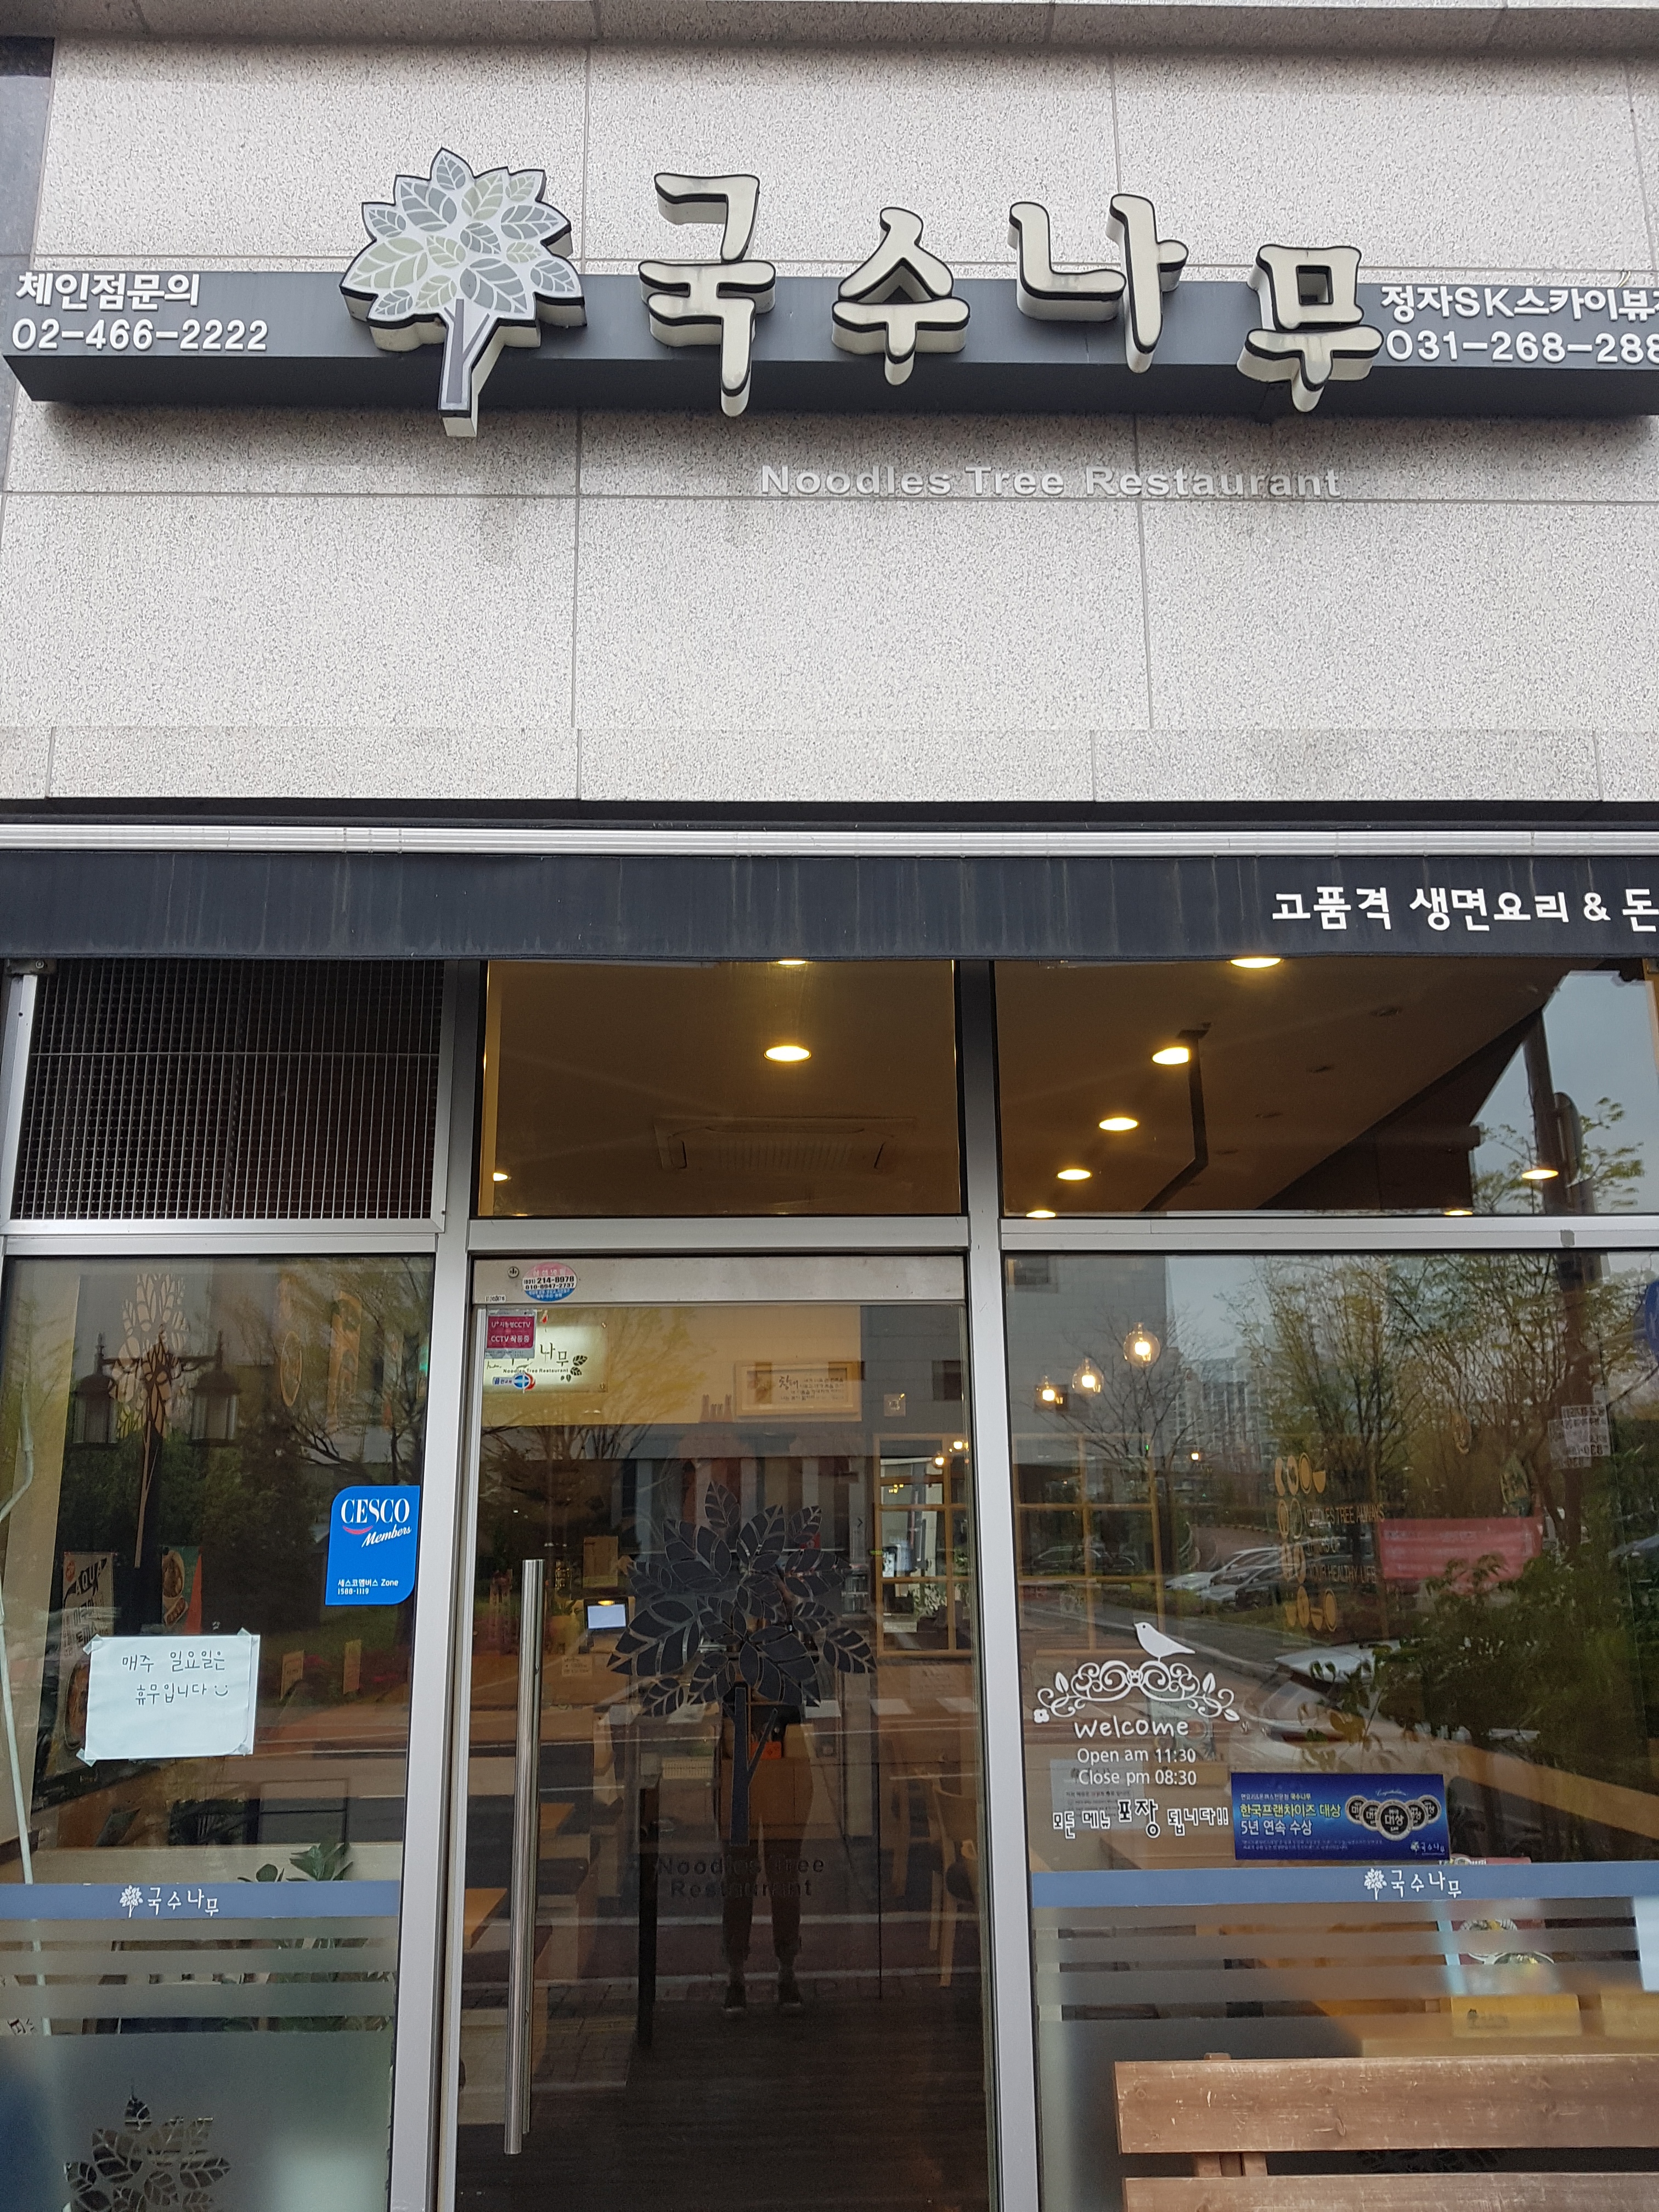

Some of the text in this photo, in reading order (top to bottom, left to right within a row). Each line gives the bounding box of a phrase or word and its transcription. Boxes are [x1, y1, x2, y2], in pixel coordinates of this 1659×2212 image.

[16, 272, 200, 311] 체인점문의
[637, 171, 1385, 413] 국수나무
[1381, 285, 1659, 323] 정자SK스카이뷰
[12, 318, 268, 351] 02-466-2222
[760, 465, 1341, 498] Noodles Tree Restaurant
[1272, 887, 1659, 932] 고품격 생면요리 & 돈
[341, 1498, 410, 1523] CESCO
[361, 1523, 412, 1548] Members
[76, 1559, 103, 1596] AQUA
[381, 1578, 399, 1587] Zone
[122, 1650, 225, 1673] 매주 일요일은
[136, 1682, 207, 1706] 휴무입니다
[1077, 1748, 1197, 1765] Open am 11:30
[1079, 1769, 1120, 1785] Close
[1126, 1771, 1150, 1786] pm
[1155, 1770, 1197, 1786] 08:30
[1053, 1811, 1075, 1839] 모든
[1082, 1810, 1111, 1829] 메뉴
[1118, 1799, 1161, 1838] 포장
[1240, 1803, 1341, 1818] 한국프랜차이즈 대상
[1384, 1814, 1404, 1826] 대상
[1241, 1819, 1313, 1836] 5년 연속 수상
[1390, 1870, 1462, 1899] 국수나무
[147, 1886, 219, 1917] 국수나무
